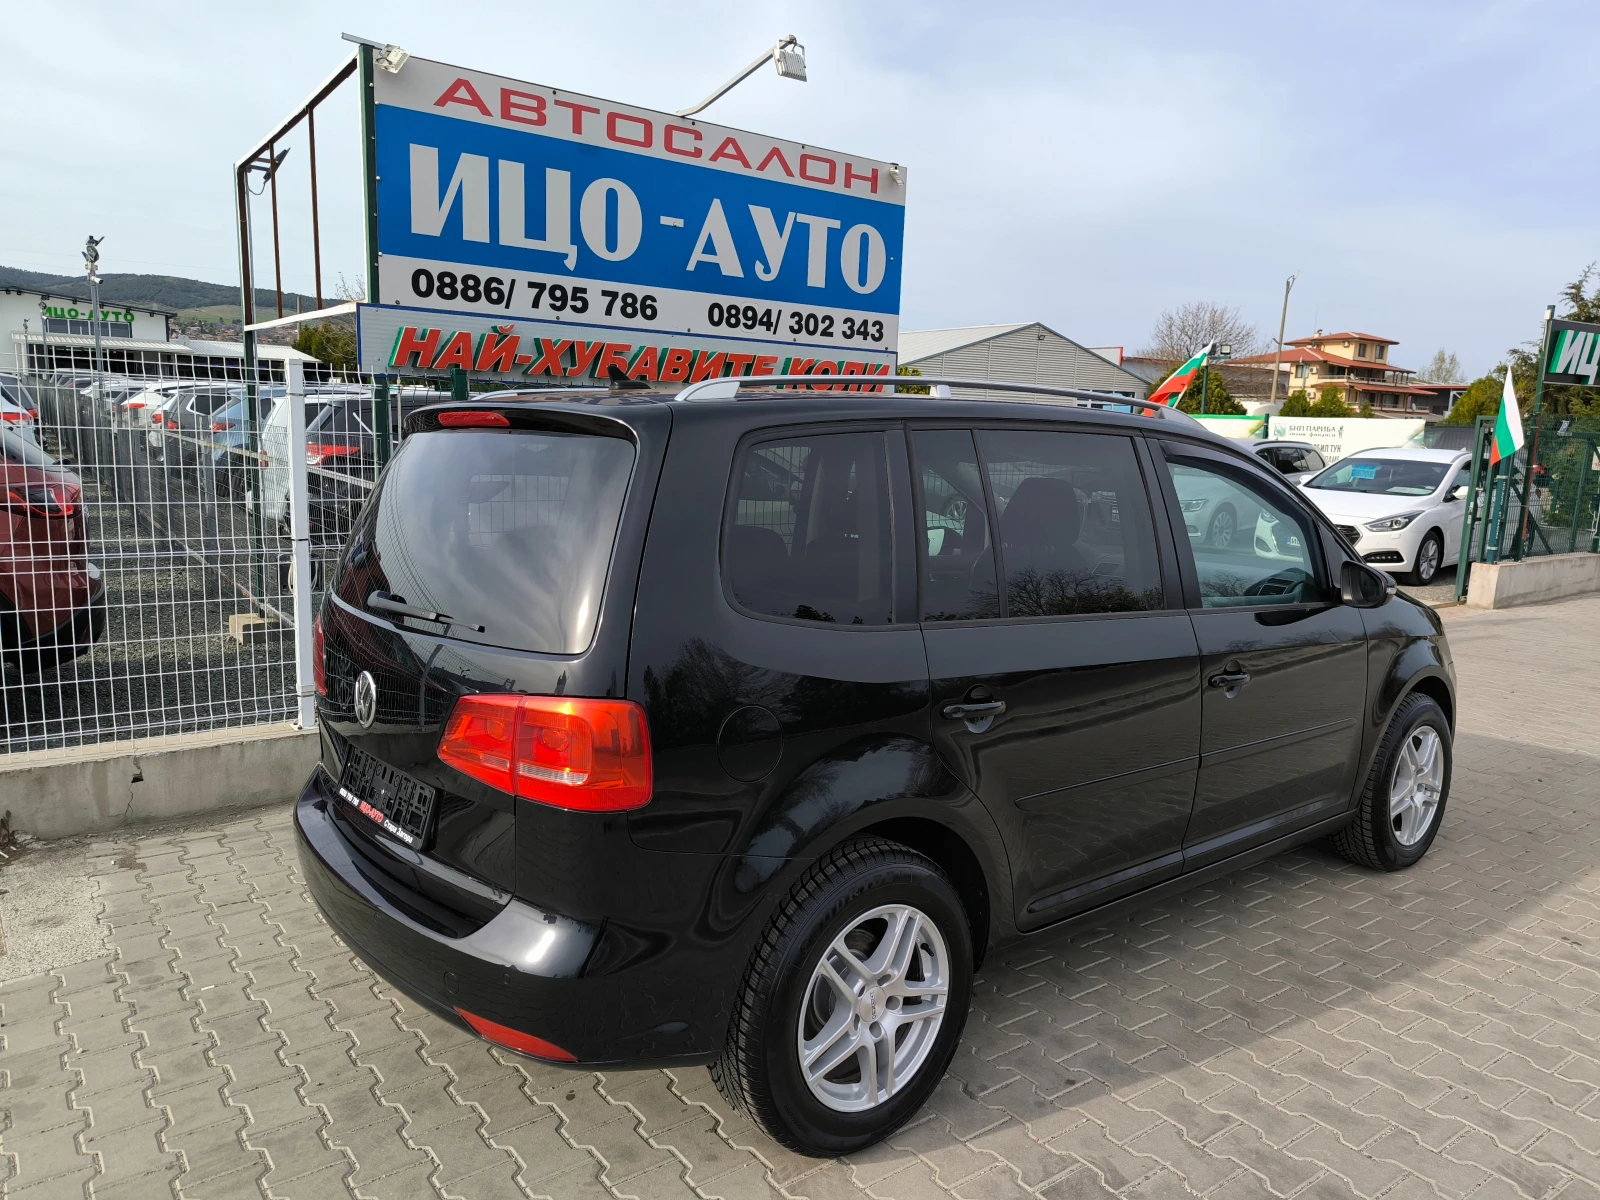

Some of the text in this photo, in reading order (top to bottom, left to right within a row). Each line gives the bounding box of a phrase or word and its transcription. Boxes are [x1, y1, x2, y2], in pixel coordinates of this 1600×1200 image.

[433, 77, 879, 195] АВТОСАЛОН
[411, 268, 658, 321] 0886/ 795 786
[707, 302, 884, 342] 0894/ 302 343
[1330, 444, 1342, 453] ТУК
